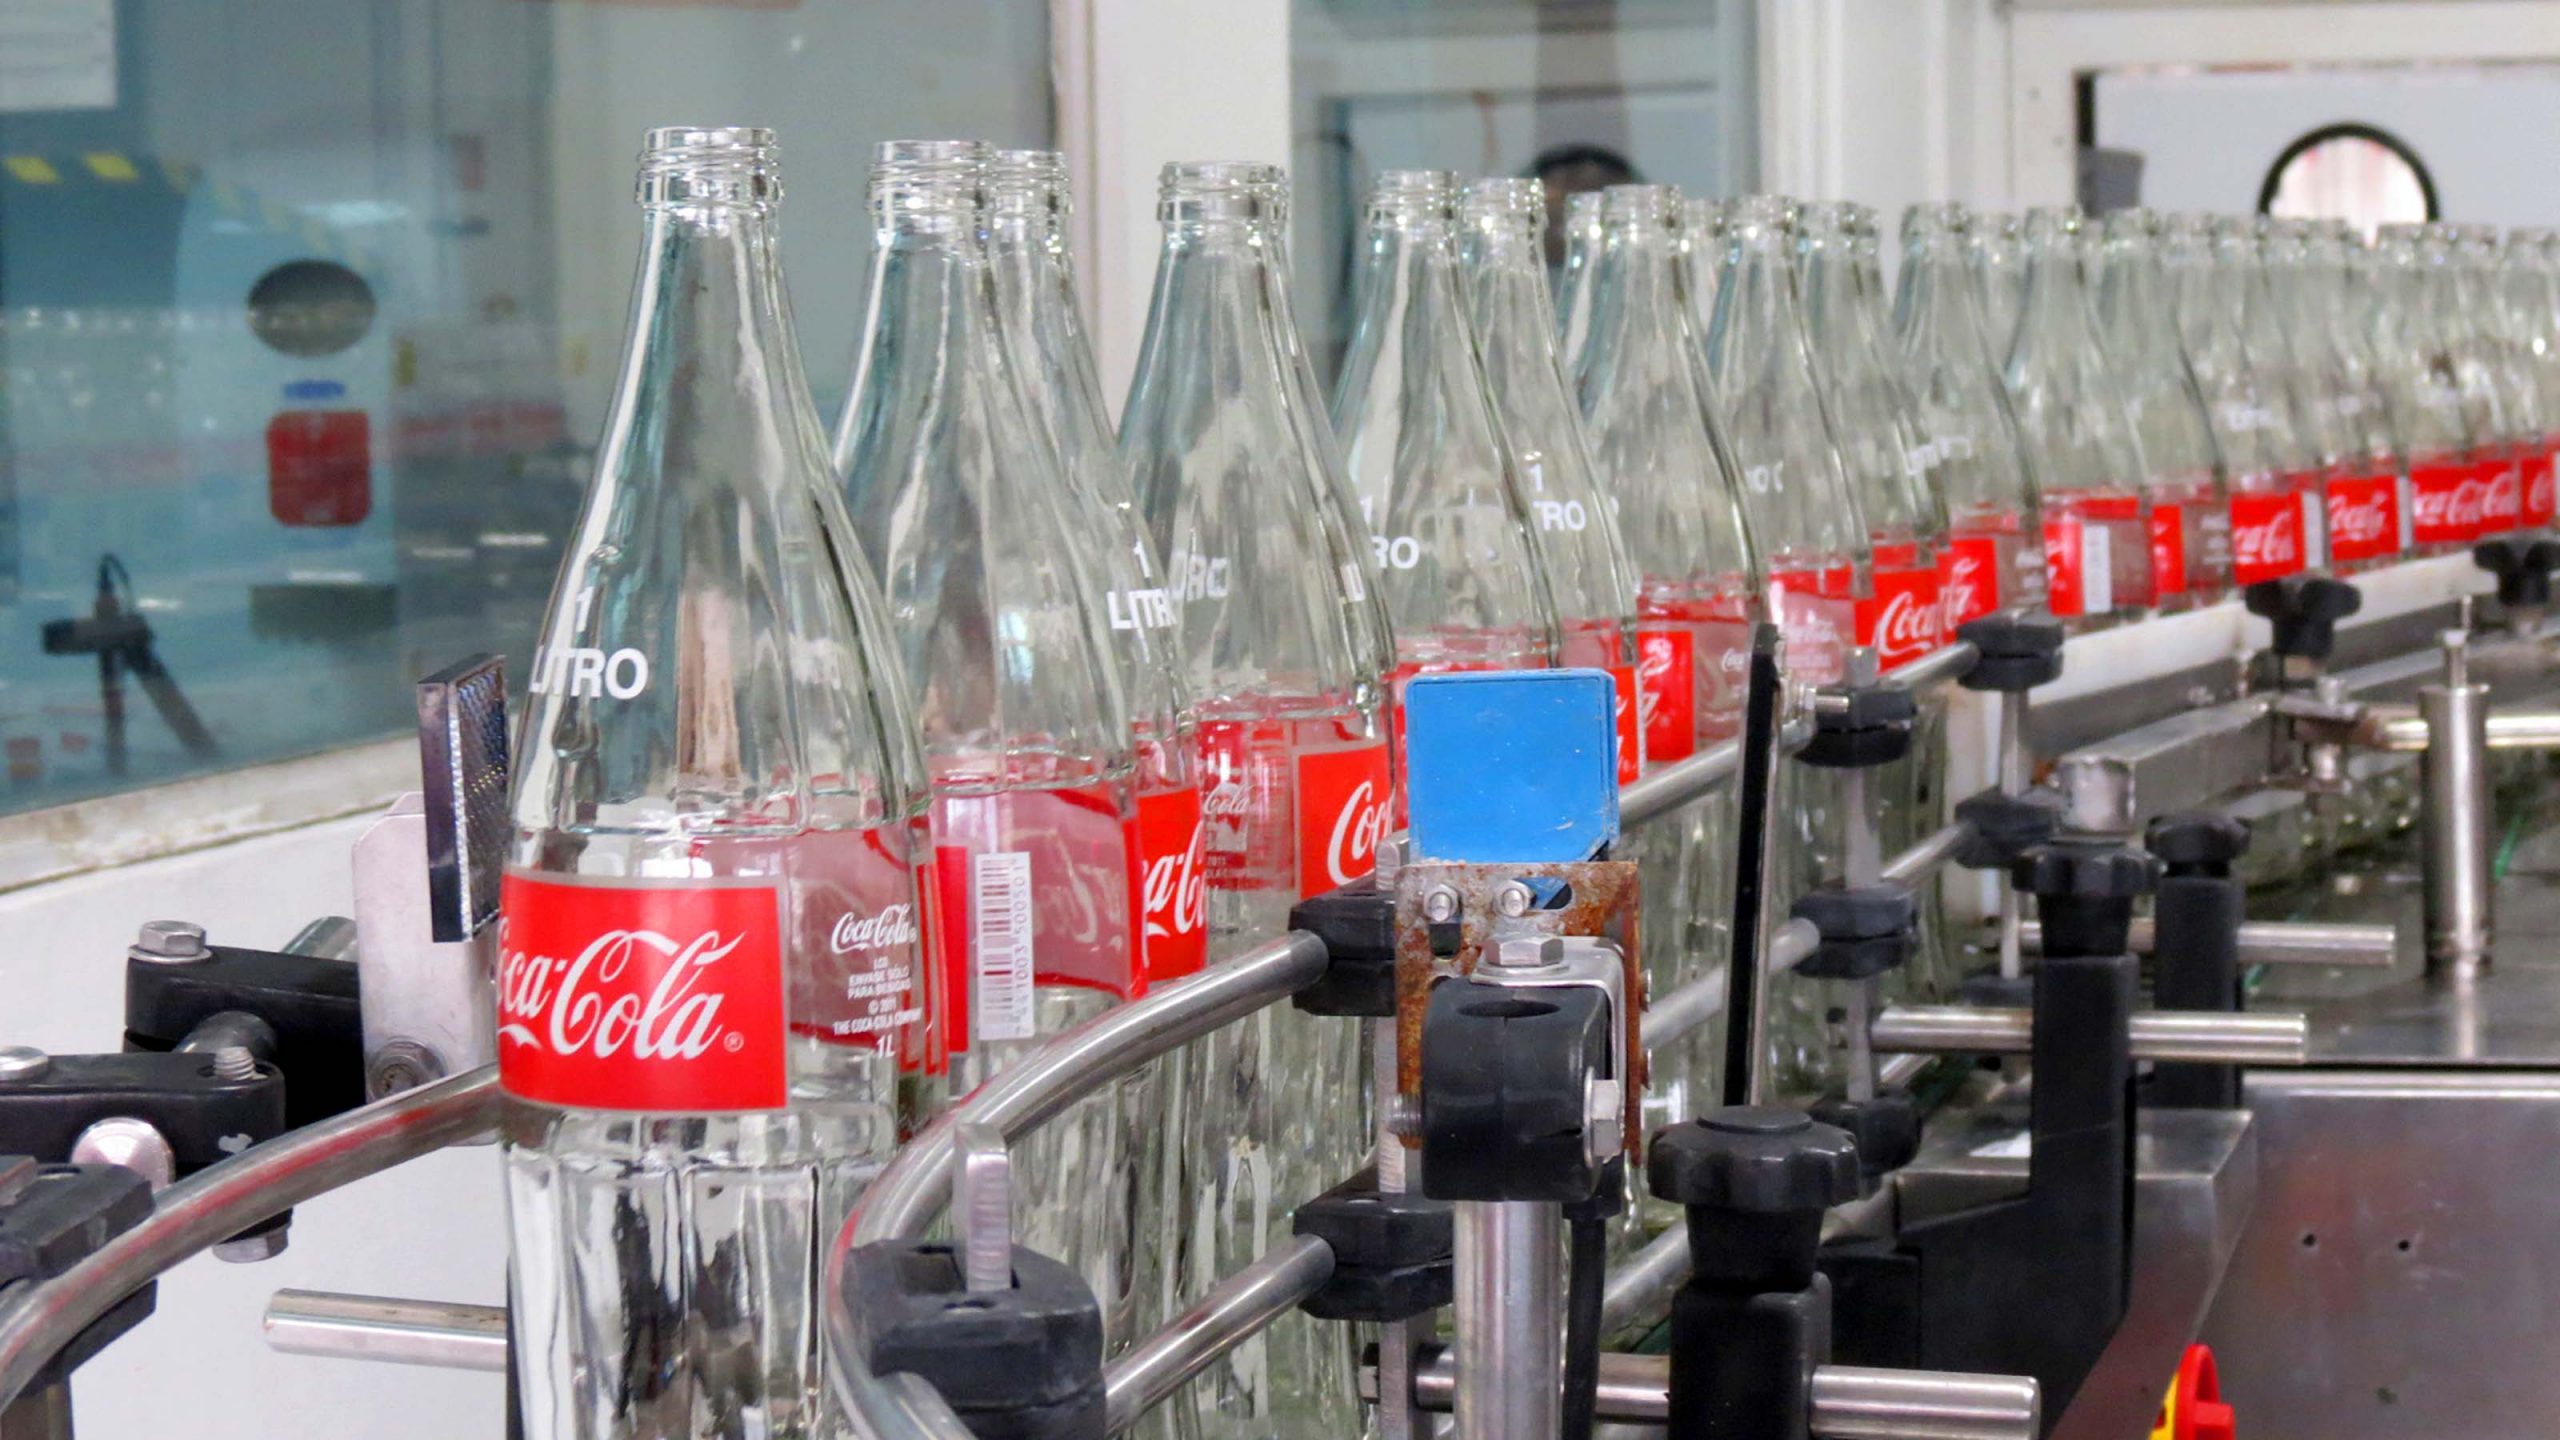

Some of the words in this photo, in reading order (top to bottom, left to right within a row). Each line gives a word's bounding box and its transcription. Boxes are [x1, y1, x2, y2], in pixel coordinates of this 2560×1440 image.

[1530, 463, 1543, 491] 1
[1132, 536, 1151, 578] 1
[575, 586, 595, 632] 1
[1106, 588, 1178, 629] LITR
